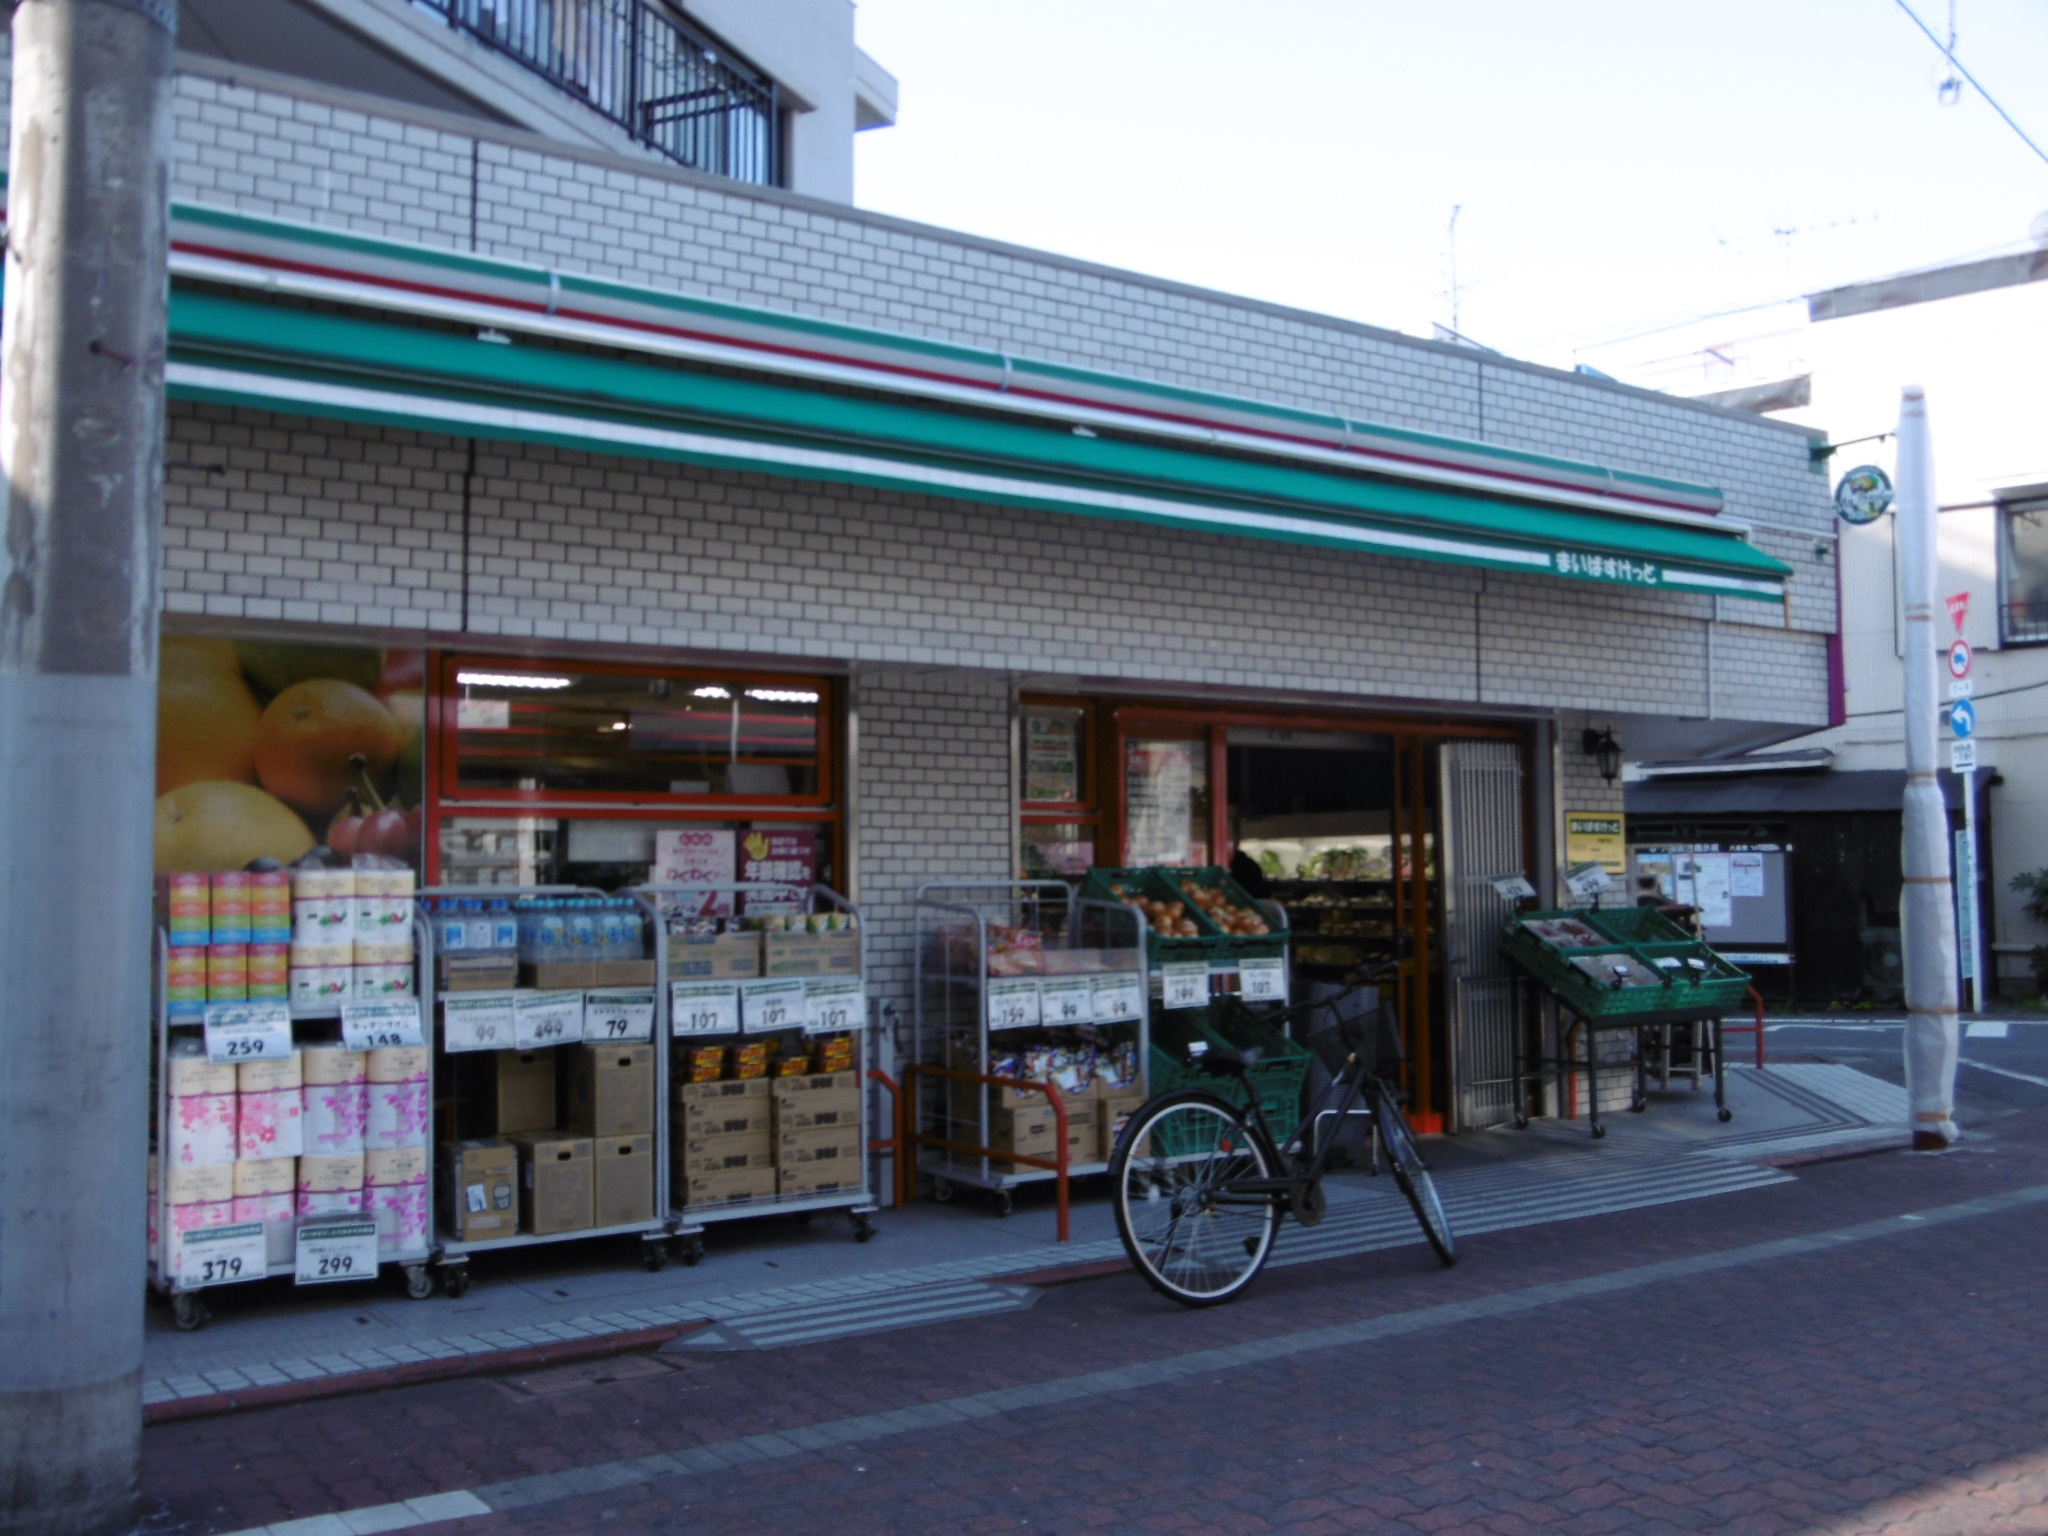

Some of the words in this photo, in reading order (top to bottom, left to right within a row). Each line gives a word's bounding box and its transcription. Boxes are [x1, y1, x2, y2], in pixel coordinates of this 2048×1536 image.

[1556, 551, 1657, 585] まいばすけっと
[691, 1012, 717, 1029] 107
[762, 1008, 785, 1024] 107
[821, 1010, 846, 1026] 107
[1001, 1008, 1024, 1023] 159
[476, 1026, 496, 1042] 99
[534, 1021, 563, 1039] 499
[606, 1019, 628, 1037] 79
[226, 1040, 264, 1055] 259
[366, 1034, 402, 1046] 148
[202, 1258, 242, 1280] 379
[318, 1256, 353, 1274] 299
